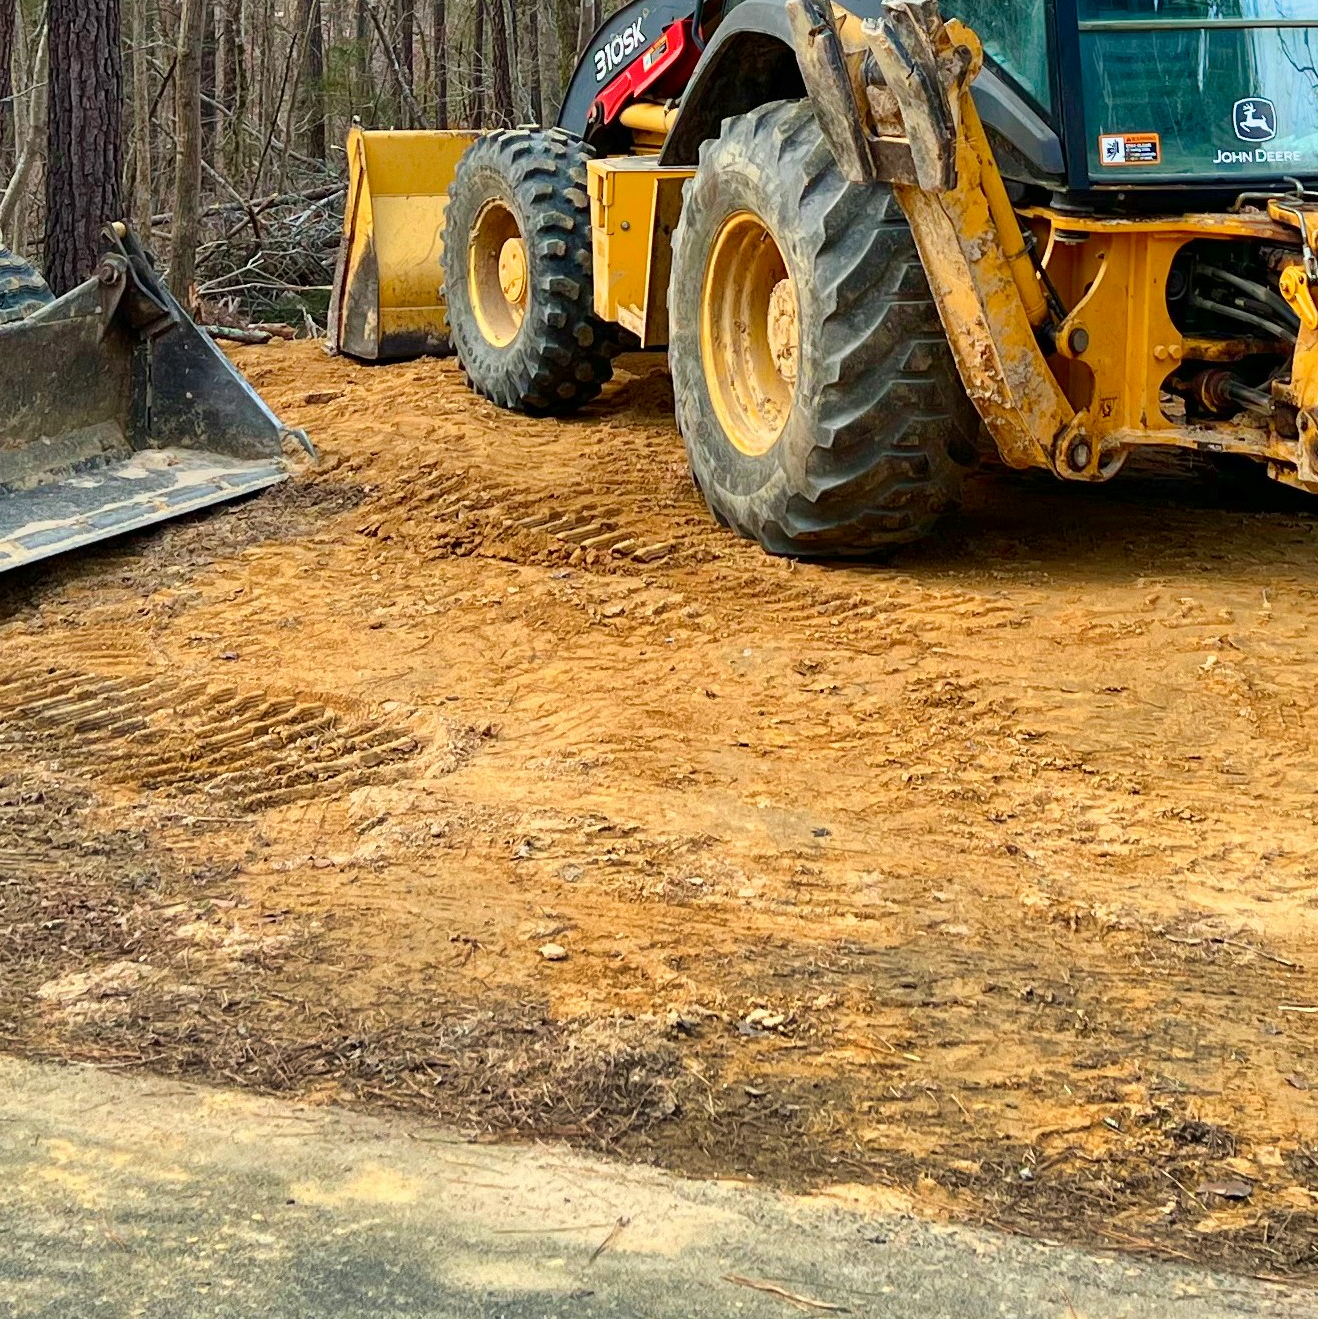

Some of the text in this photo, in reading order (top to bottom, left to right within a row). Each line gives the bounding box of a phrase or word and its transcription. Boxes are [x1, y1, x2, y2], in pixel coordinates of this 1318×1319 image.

[594, 16, 646, 81] 310SK
[1213, 148, 1302, 164] JOHN DEERE
